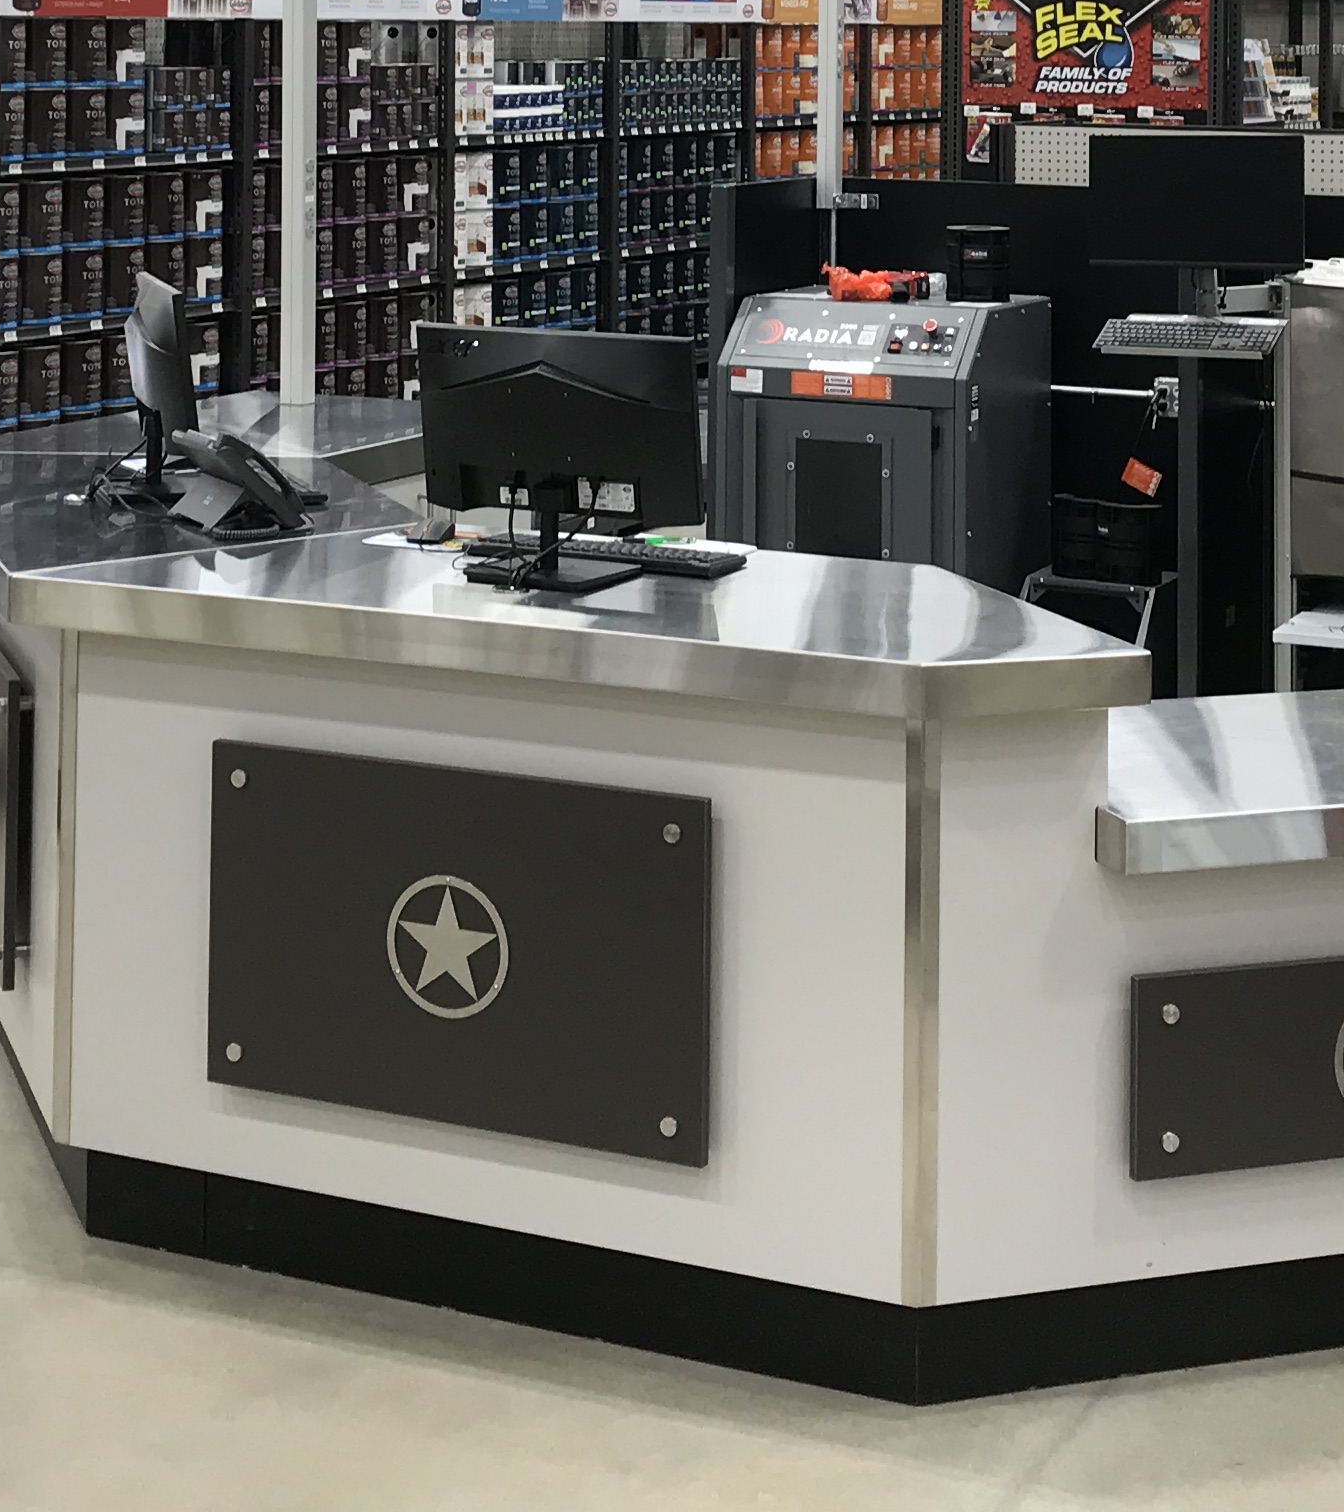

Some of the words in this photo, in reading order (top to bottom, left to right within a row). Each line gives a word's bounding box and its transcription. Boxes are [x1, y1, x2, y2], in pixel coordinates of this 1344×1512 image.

[1035, 1, 1124, 32] FLEX
[1035, 22, 1123, 60] SEAL
[1039, 66, 1106, 79] FAMILY
[1108, 67, 1132, 80] OF
[1035, 81, 1128, 94] PRODUCTS
[783, 327, 852, 344] RADIA
